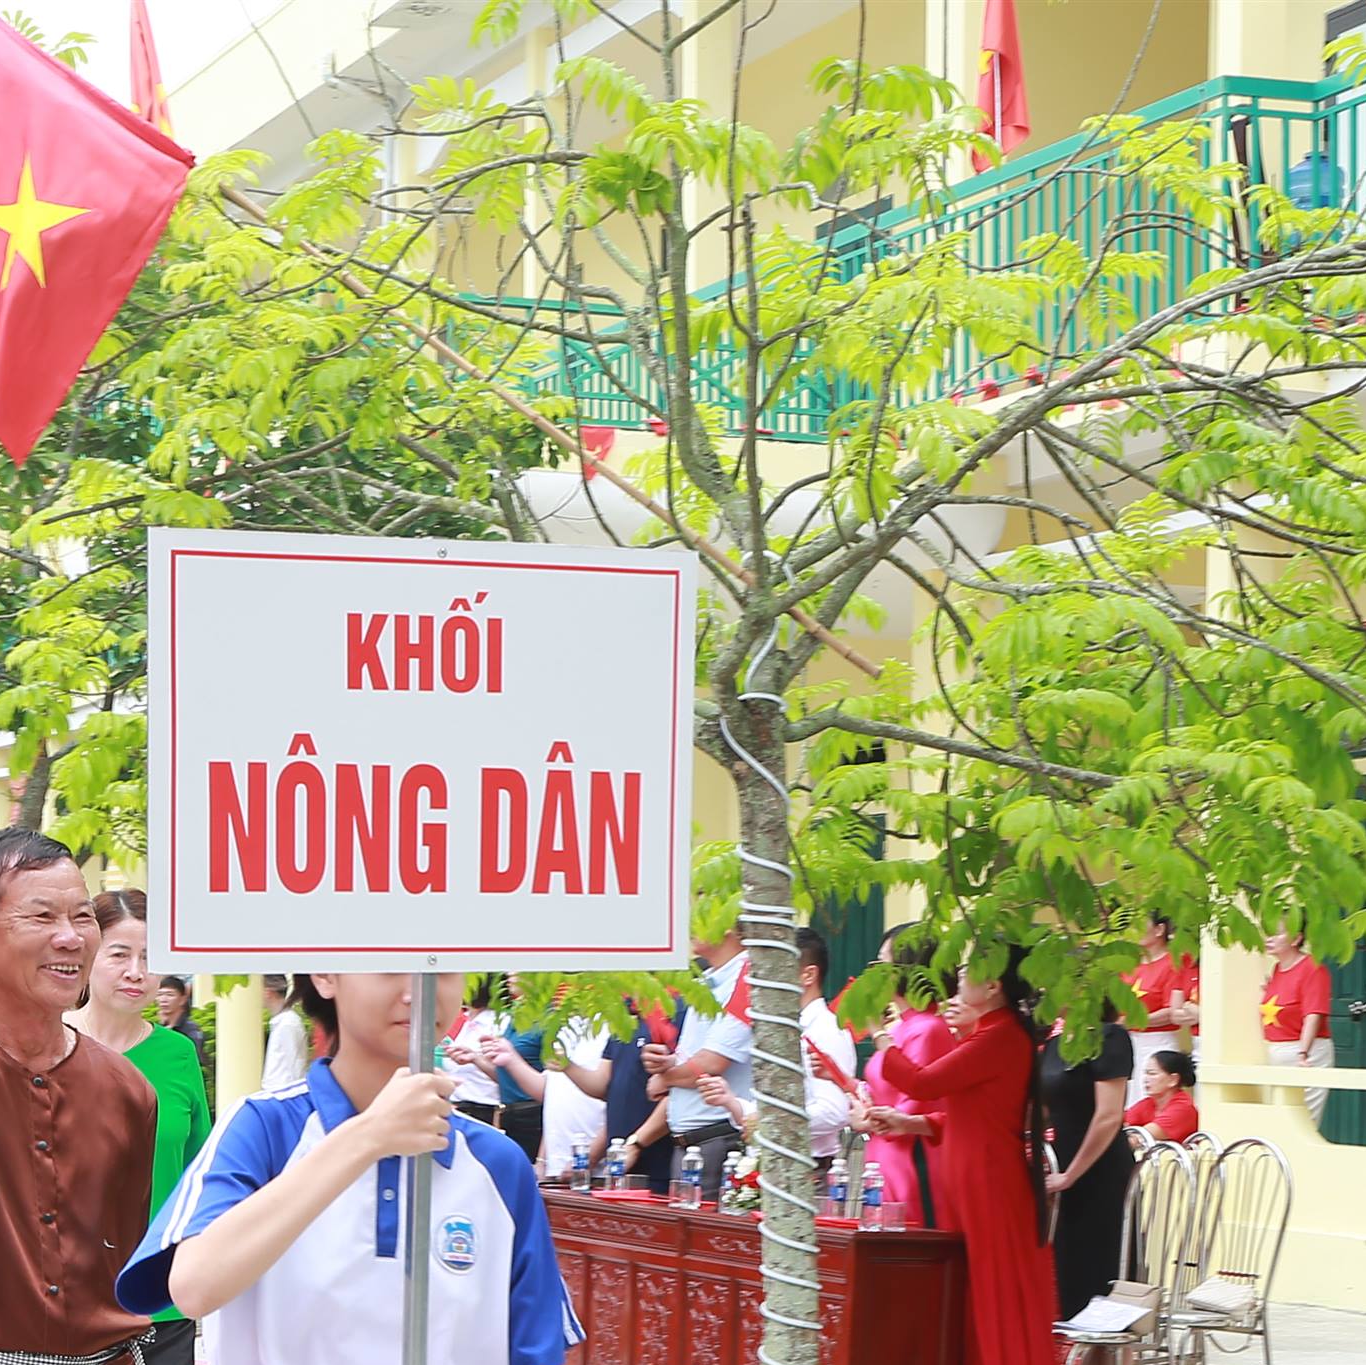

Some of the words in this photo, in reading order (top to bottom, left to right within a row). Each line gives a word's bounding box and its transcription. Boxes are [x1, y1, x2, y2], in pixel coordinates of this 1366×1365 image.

[346, 591, 503, 693] KHỐI
[209, 733, 448, 895] NÔNG
[480, 741, 641, 896] DÂN
